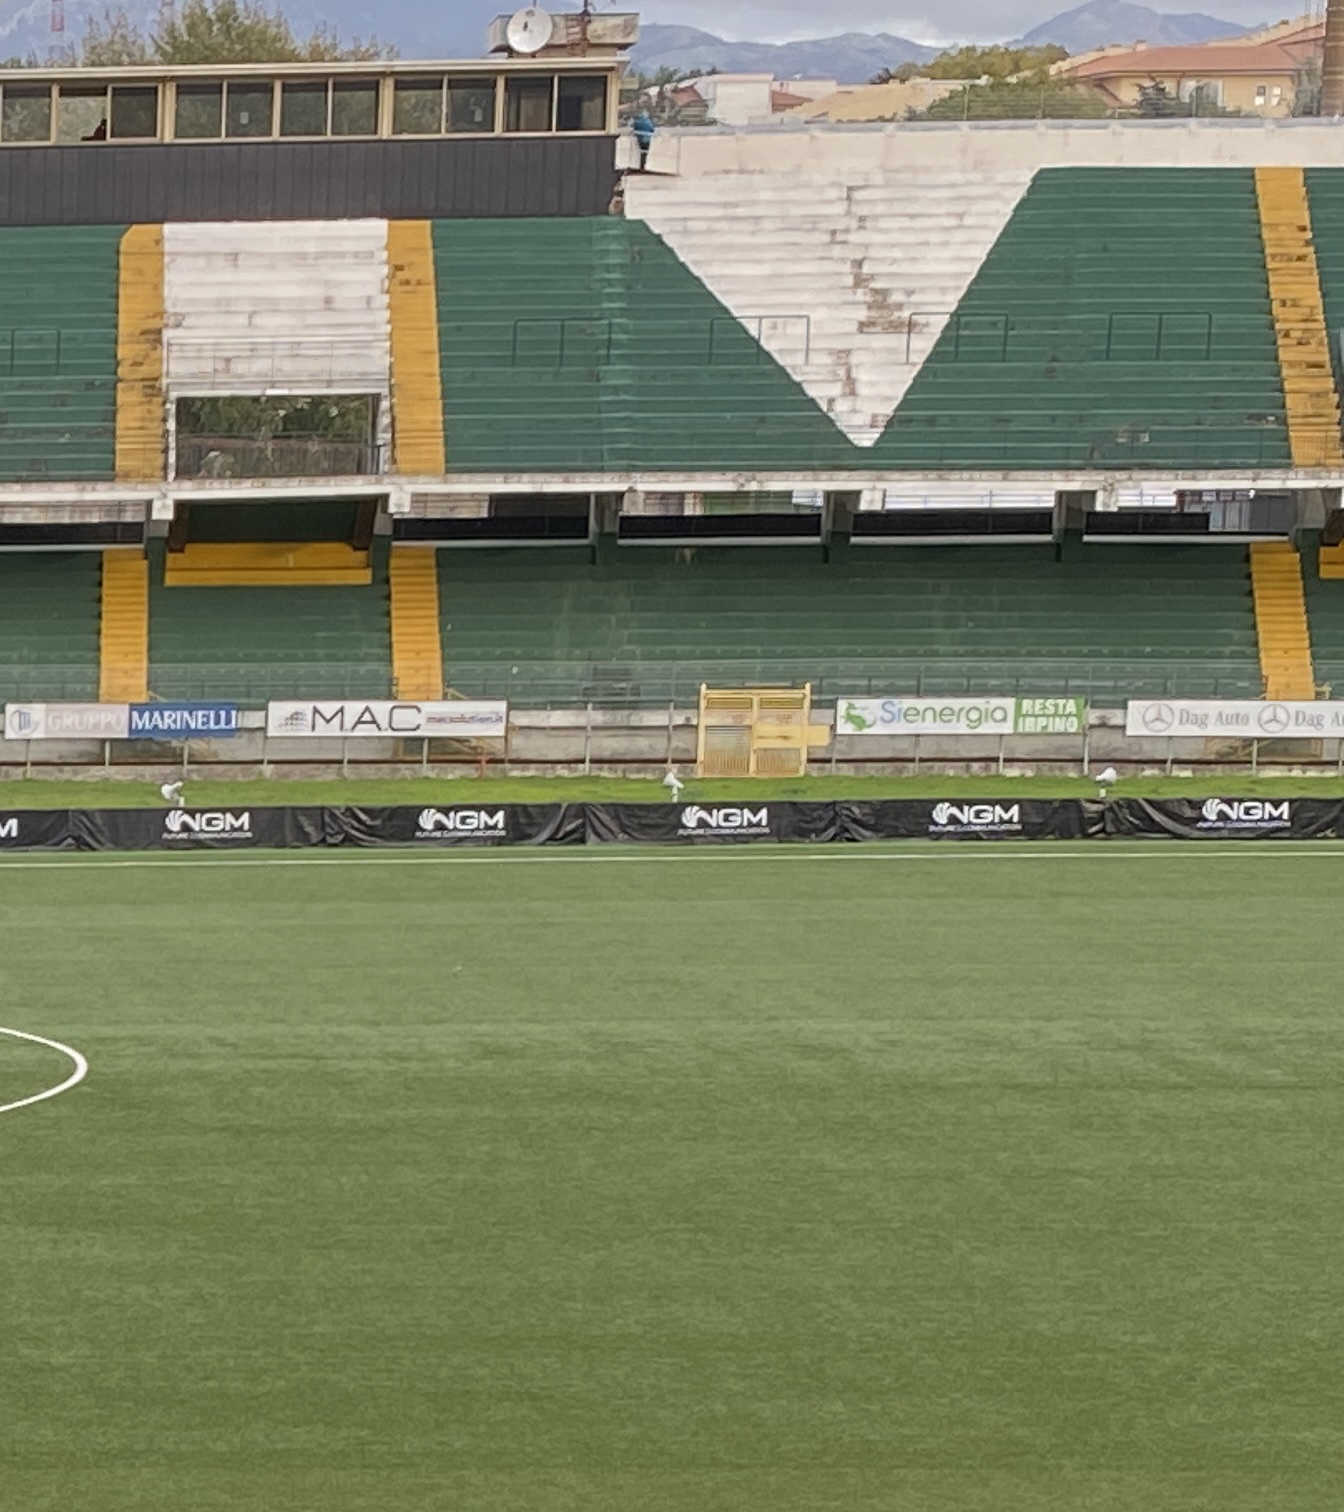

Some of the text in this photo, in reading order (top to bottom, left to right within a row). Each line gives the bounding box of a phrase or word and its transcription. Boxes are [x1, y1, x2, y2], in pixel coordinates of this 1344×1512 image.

[879, 700, 1008, 730] Sienergia
[1021, 698, 1077, 715] RESTA
[47, 711, 124, 730] GRUPPO
[131, 710, 236, 730] MARINELLI
[1178, 709, 1250, 728] Dag Auto
[1295, 710, 1325, 728] Dag
[432, 810, 505, 830] NGM
[695, 807, 768, 827] NGM
[949, 804, 1019, 823] NGM
[1217, 801, 1289, 820] NGM
[180, 812, 250, 831] NGM
